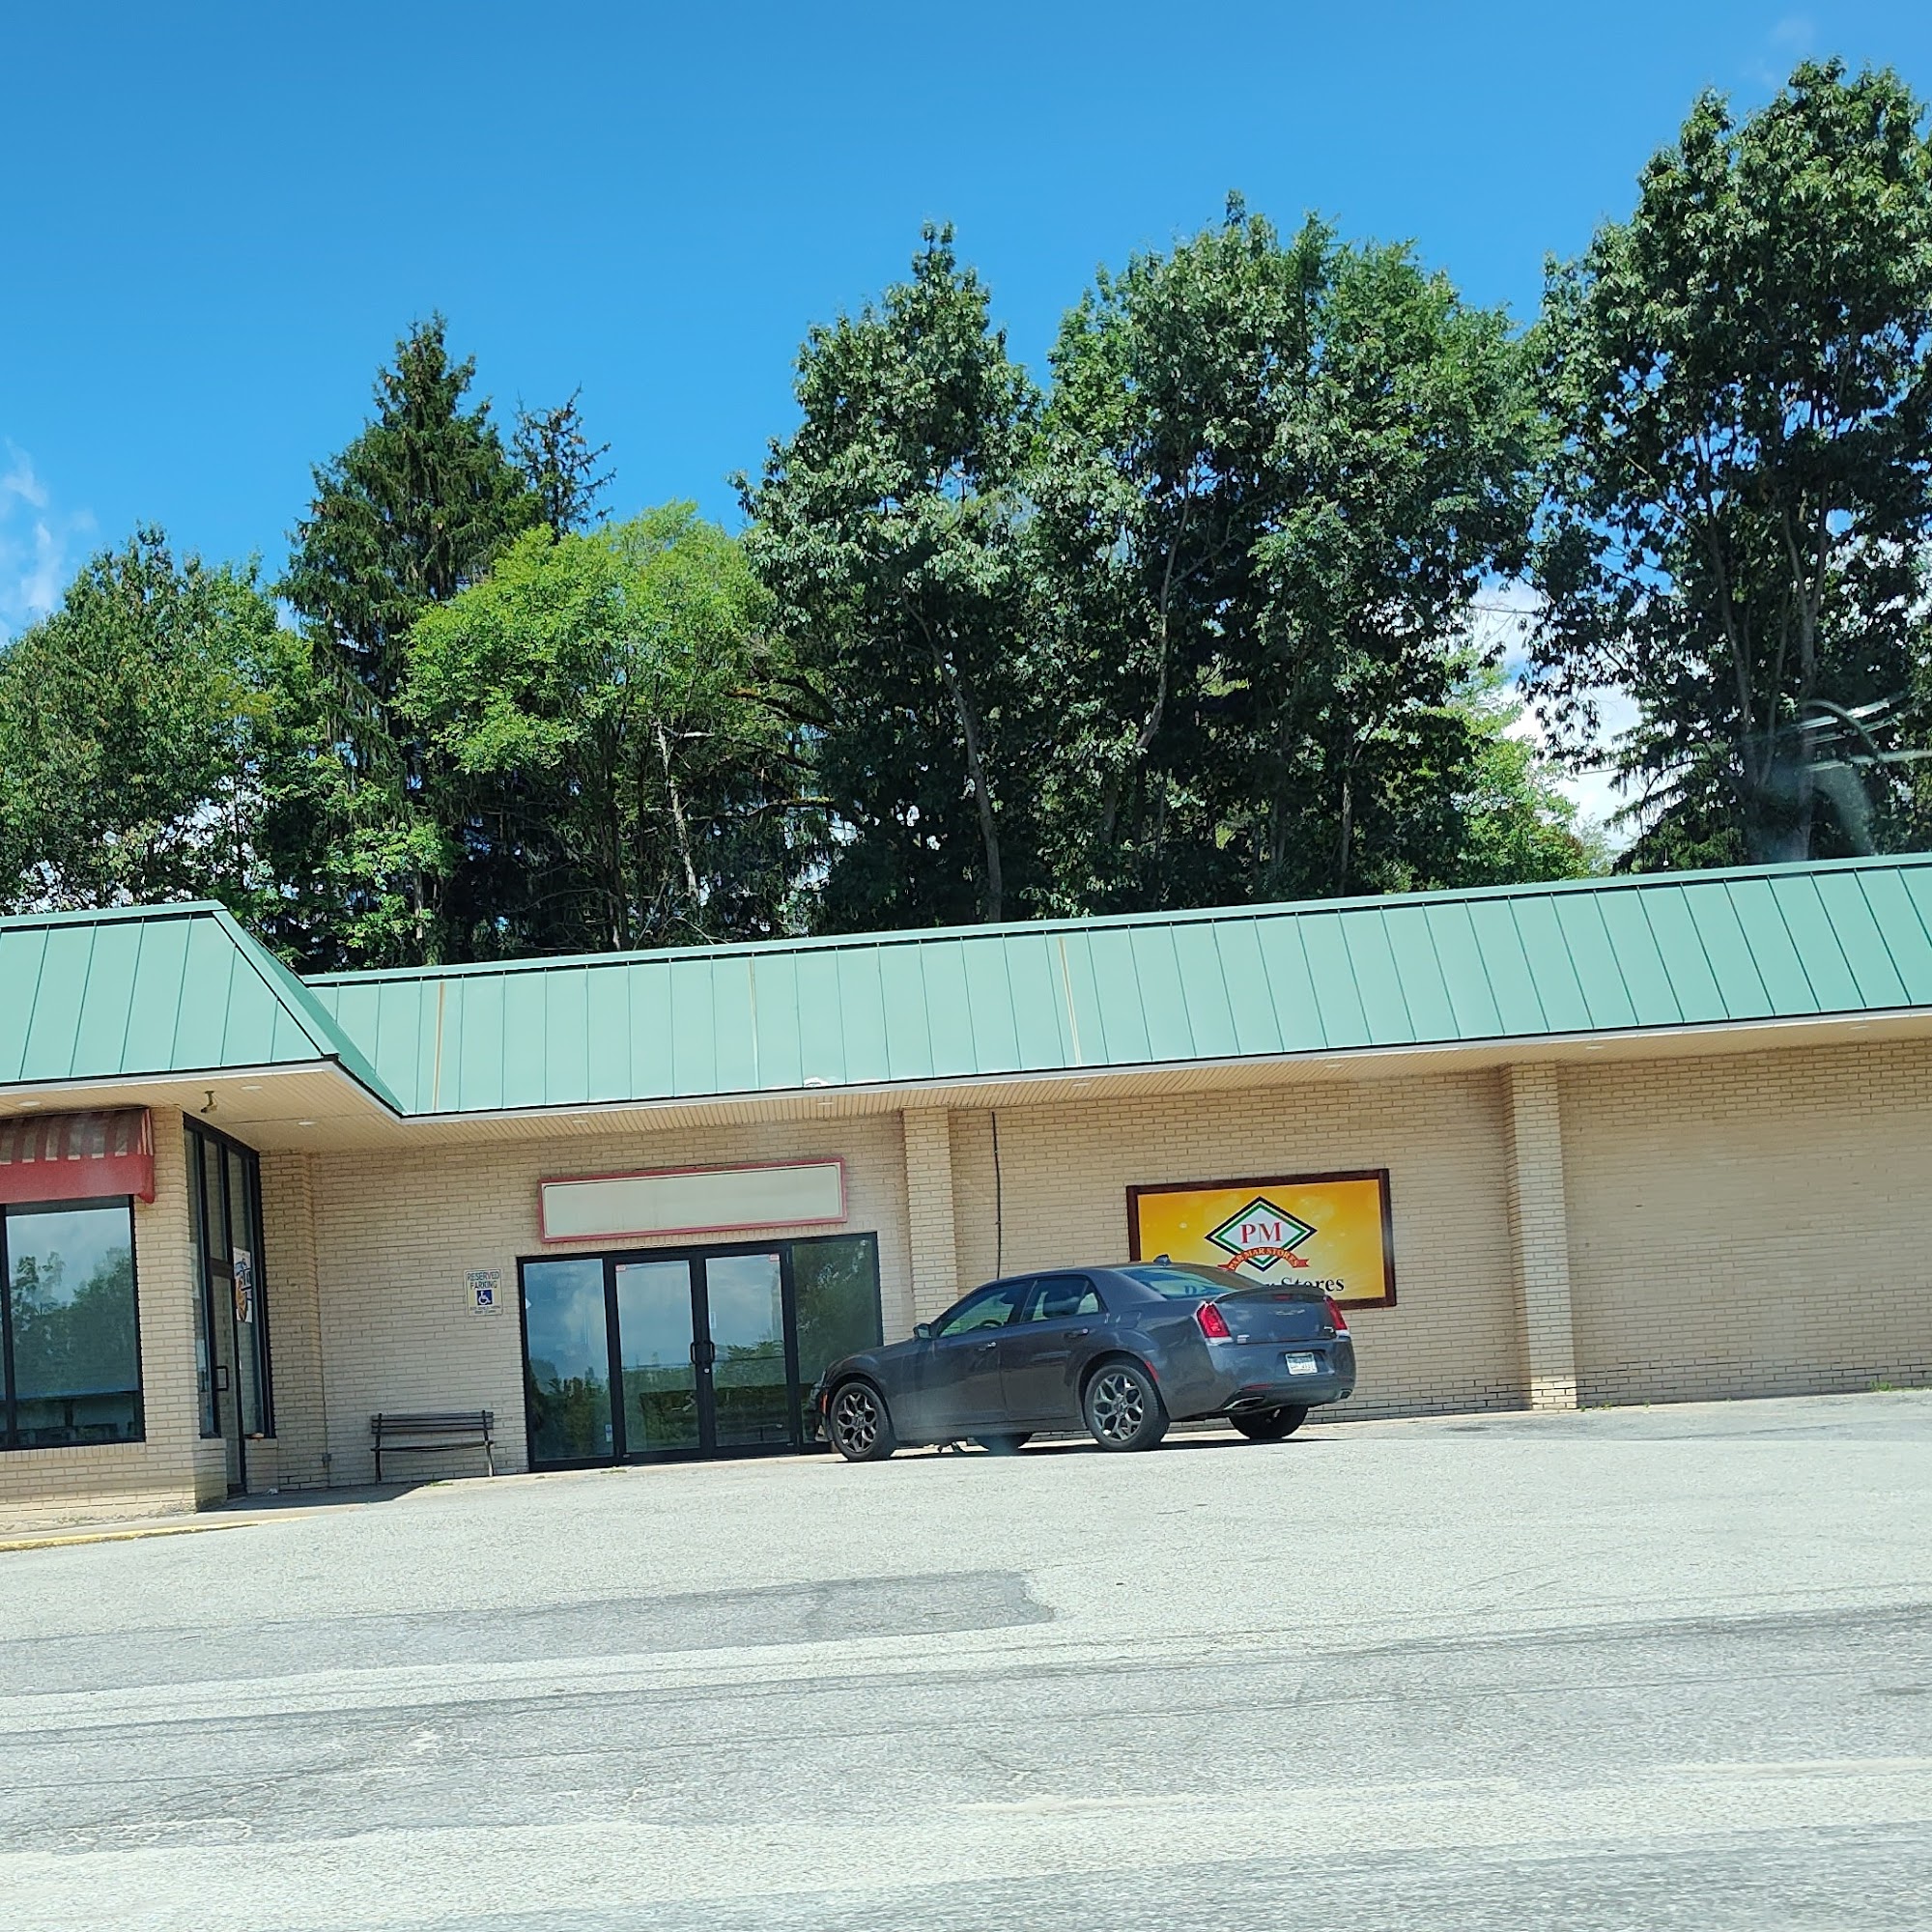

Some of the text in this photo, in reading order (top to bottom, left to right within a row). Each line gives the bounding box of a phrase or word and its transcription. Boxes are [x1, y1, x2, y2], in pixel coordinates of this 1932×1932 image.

[1239, 1221, 1282, 1244] PM
[1265, 1247, 1298, 1267] STORES
[467, 1270, 499, 1281] RESERVED
[469, 1280, 497, 1290] PARKING
